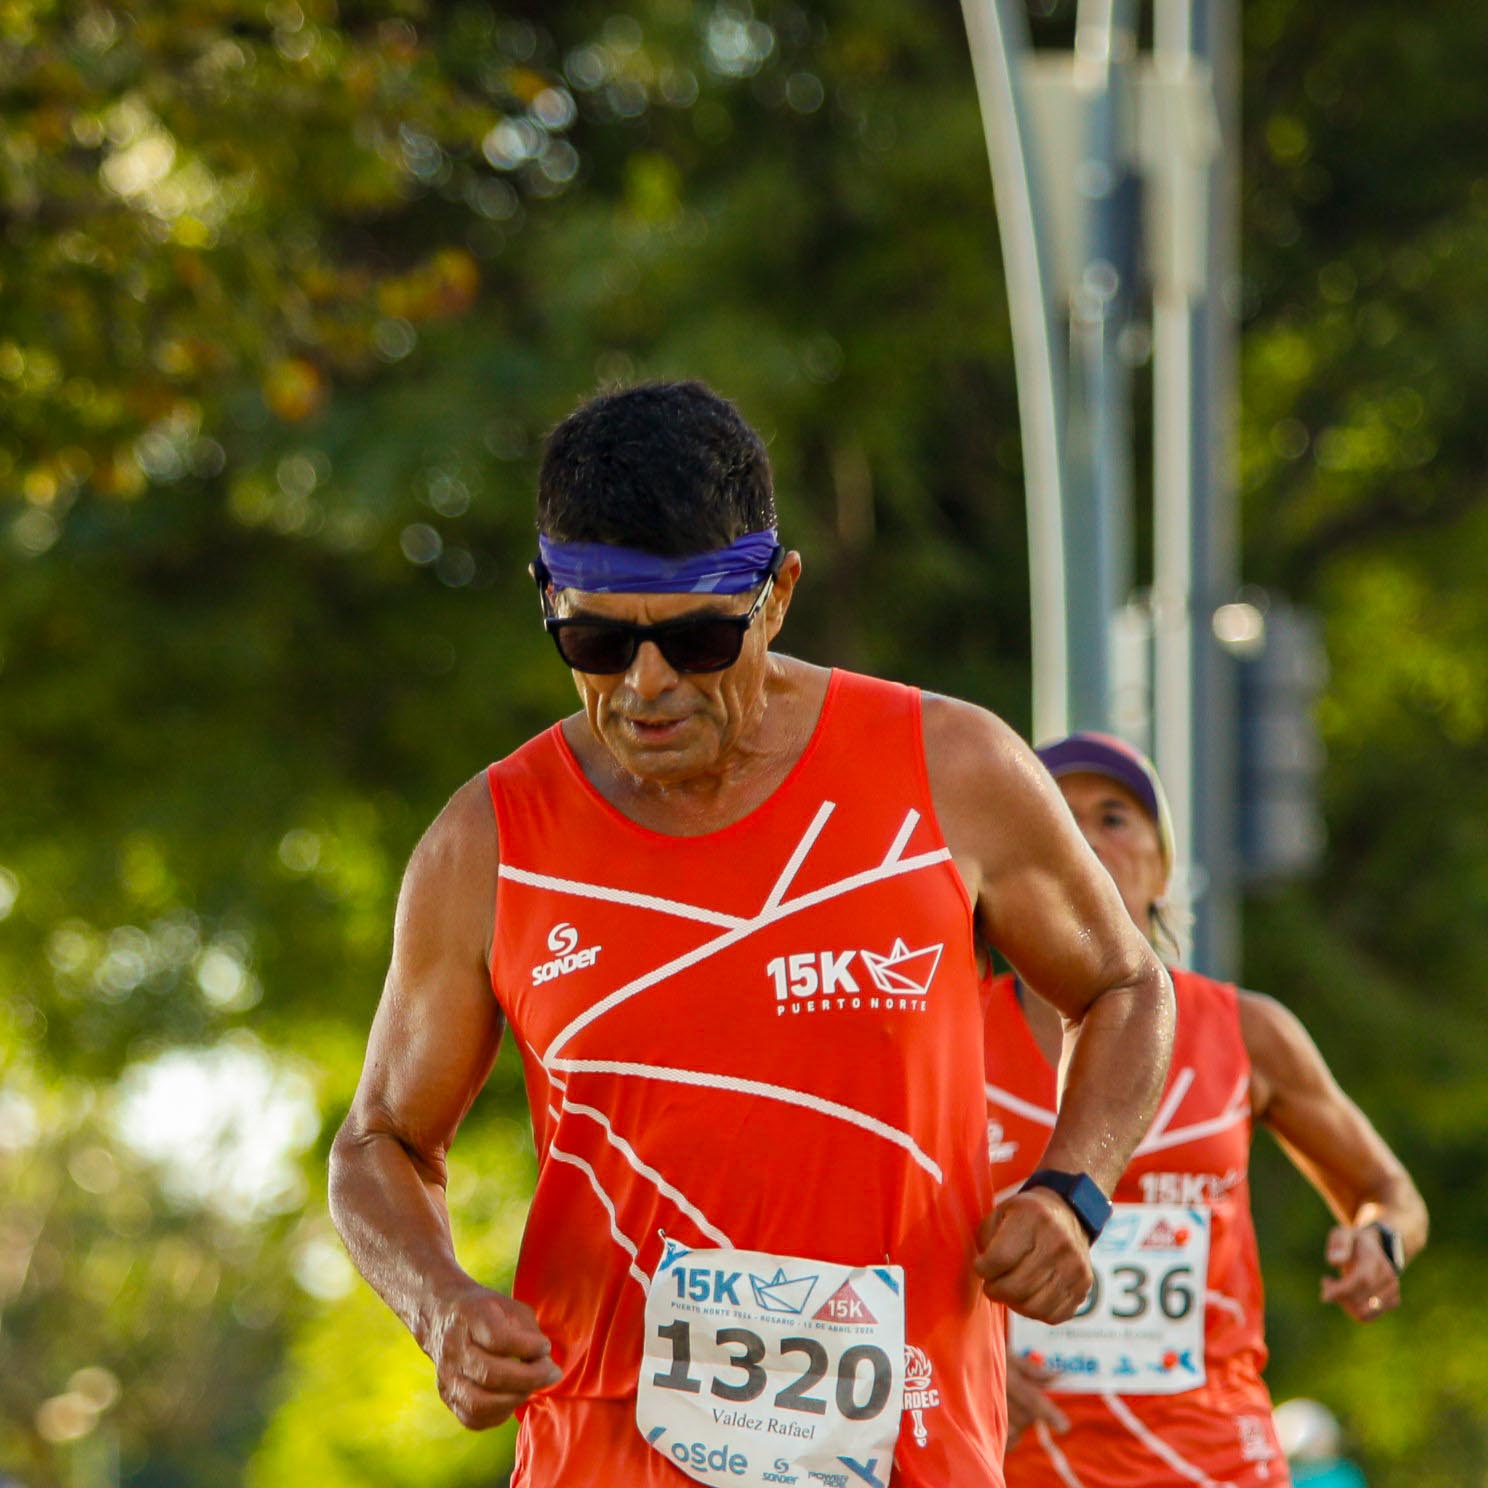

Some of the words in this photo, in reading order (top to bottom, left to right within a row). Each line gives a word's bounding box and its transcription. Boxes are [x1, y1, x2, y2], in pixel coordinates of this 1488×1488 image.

[767, 950, 861, 1000] 15K
[777, 998, 861, 1016] PUERTO
[871, 998, 928, 1012] NORTE
[671, 1266, 741, 1306] 15K
[704, 1307, 730, 1317] NORTE
[829, 1300, 863, 1319] 15K
[653, 1319, 893, 1421] 1320
[904, 1389, 941, 1410] RDEC
[712, 1408, 763, 1431] Valdez
[767, 1418, 816, 1440] Rafael
[671, 1442, 749, 1475] osde
